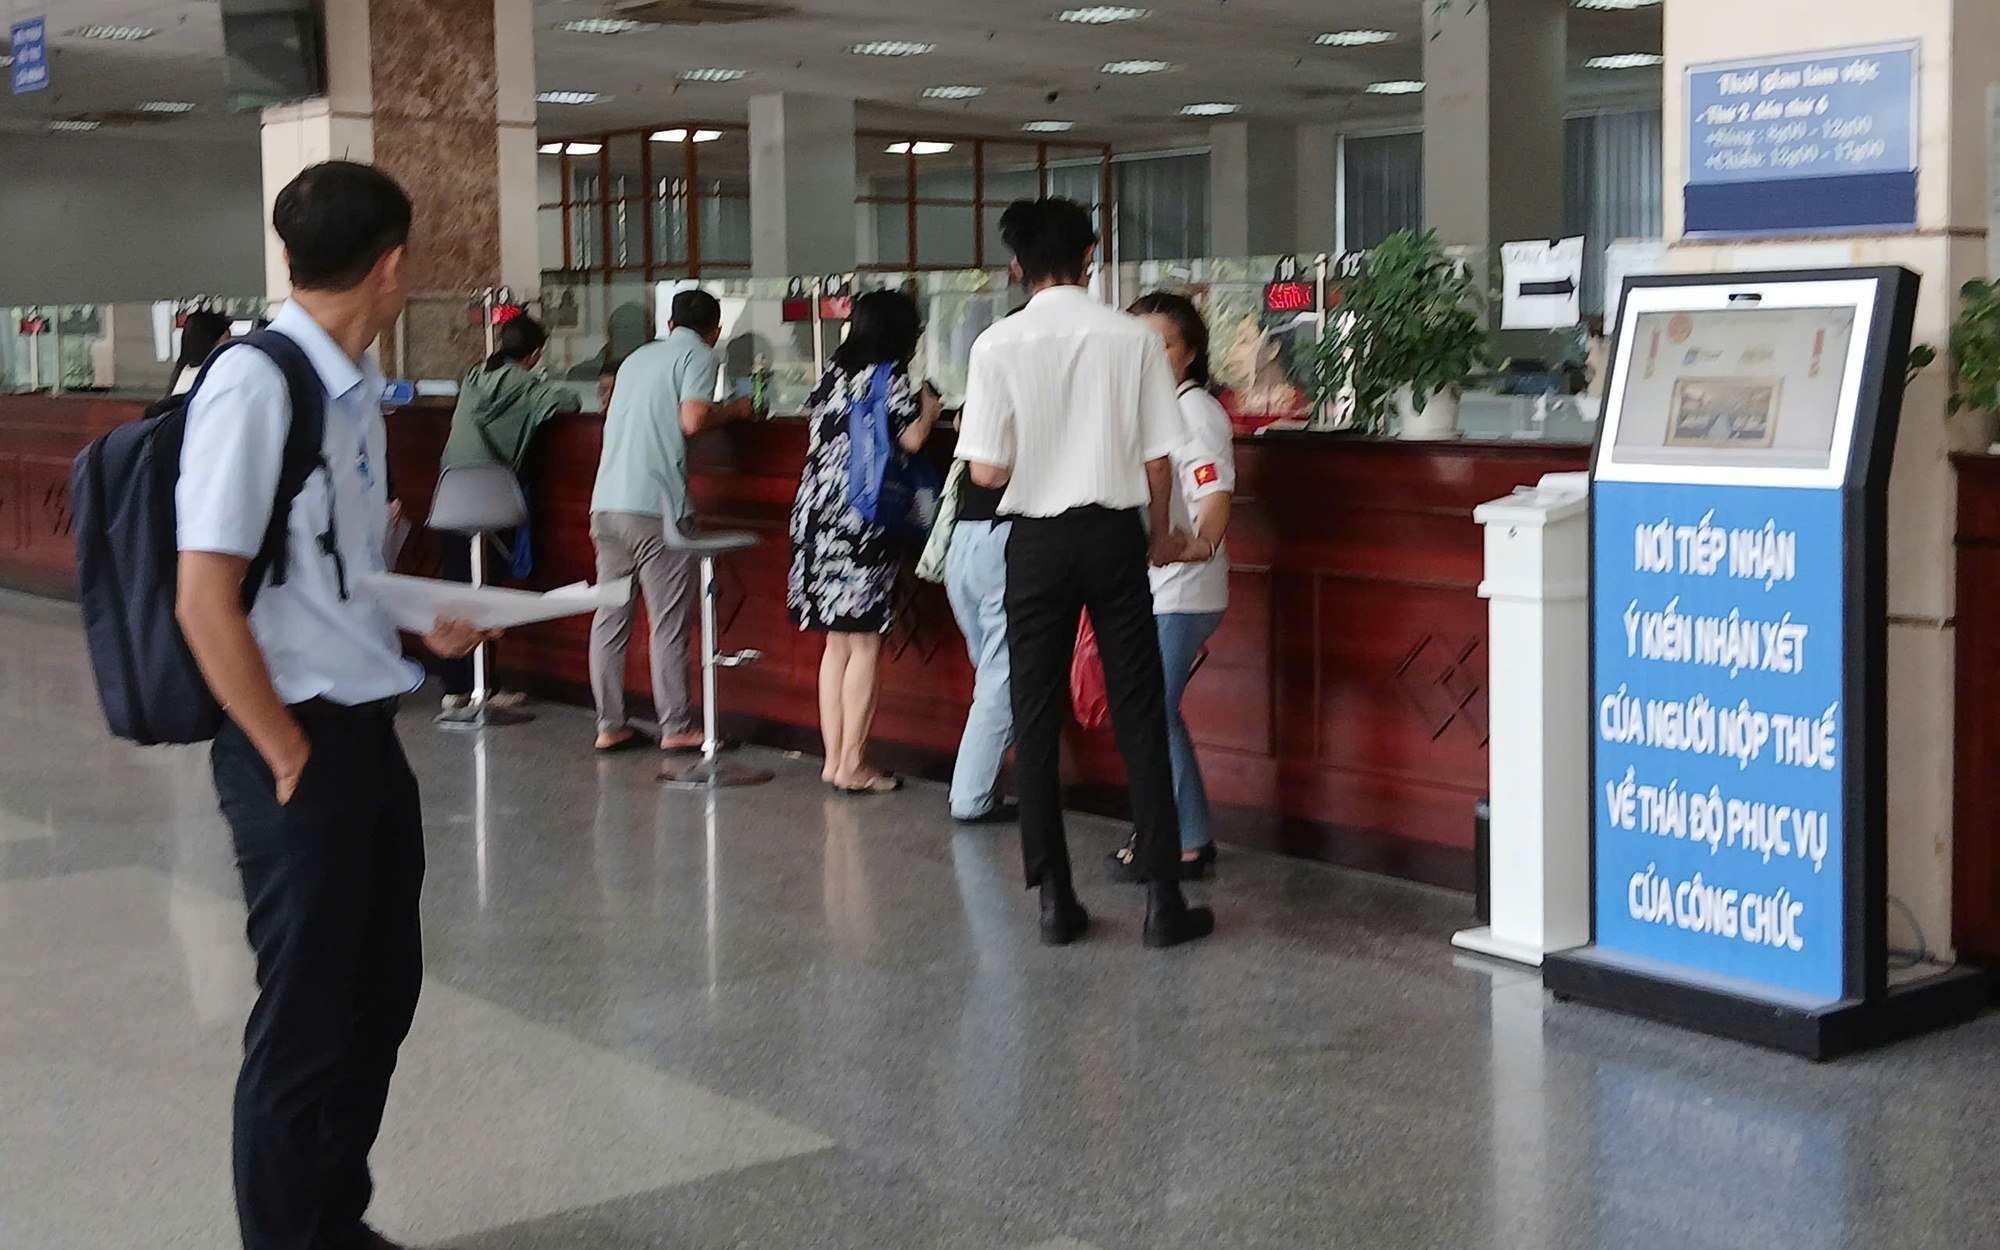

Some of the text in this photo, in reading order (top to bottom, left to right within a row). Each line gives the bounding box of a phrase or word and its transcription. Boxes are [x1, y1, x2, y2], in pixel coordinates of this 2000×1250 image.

[1737, 101, 1750, 122] 2
[1815, 94, 1829, 116] 6
[1634, 508, 1796, 592] NƠI TIẾP NHẬN
[1623, 595, 1808, 680] Ý KIẾN NHẬN XÉT
[1600, 683, 1839, 771] CỦA NGƯỜI NỘP THUẾ
[1606, 764, 1828, 874] VỀ THÁI ĐỘ PHỤC VỤ
[1628, 861, 1803, 952] CỦA CÔNG CHỨC
